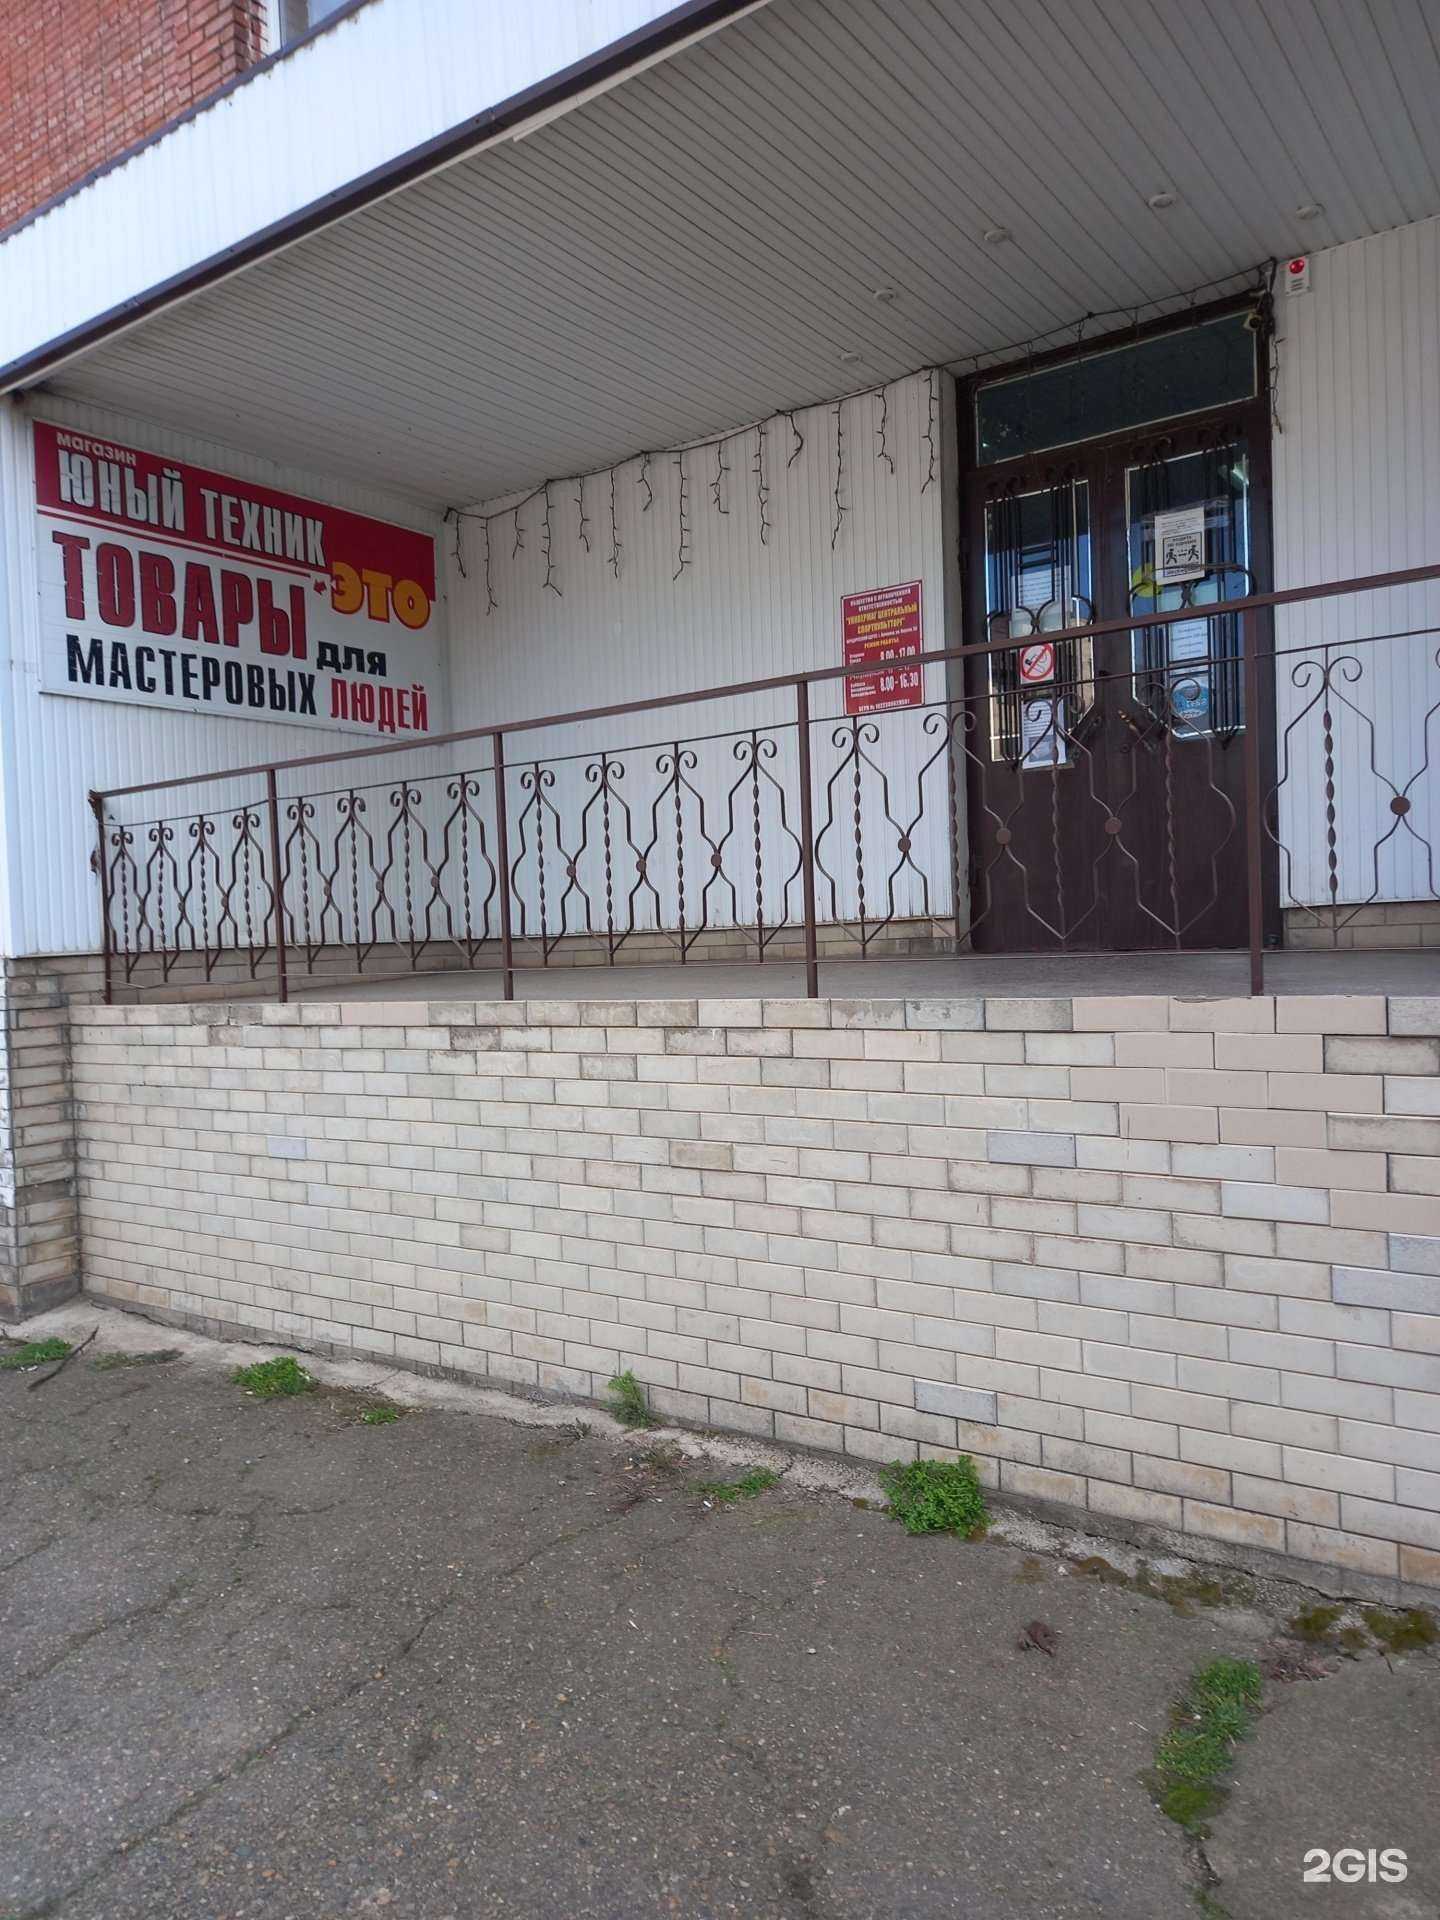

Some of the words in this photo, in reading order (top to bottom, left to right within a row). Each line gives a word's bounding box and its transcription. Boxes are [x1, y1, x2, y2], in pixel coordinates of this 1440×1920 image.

[56, 432, 137, 466] магазин
[57, 448, 185, 532] ЮНЫЙ
[200, 487, 326, 567] ТЕХНИК
[52, 531, 308, 660] ТОВАРЫ
[331, 562, 431, 630] ЭТО
[66, 634, 317, 715] МАСТЕРОВЫХ
[330, 679, 428, 733] ЛЮДЕЙ
[316, 641, 386, 677] для
